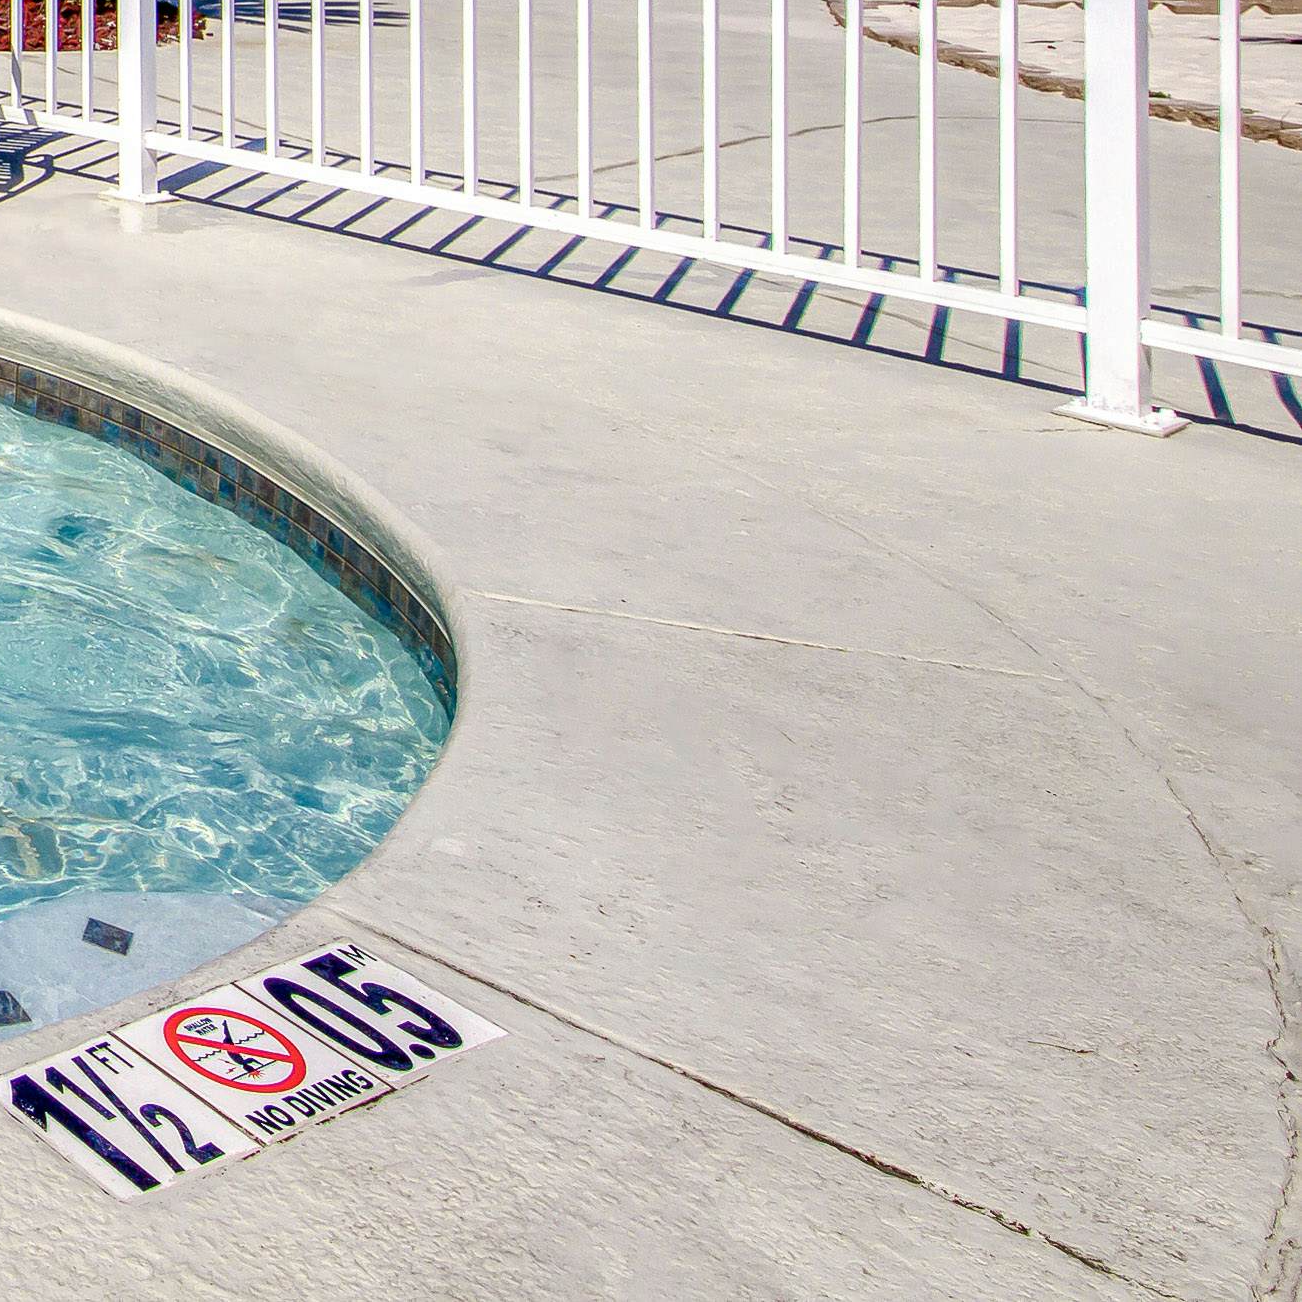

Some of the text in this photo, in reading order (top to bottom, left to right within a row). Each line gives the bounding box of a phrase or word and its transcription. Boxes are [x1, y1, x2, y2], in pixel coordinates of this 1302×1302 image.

[336, 943, 378, 968] M
[86, 1041, 136, 1076] FT
[244, 1068, 375, 1136] NO DIVING
